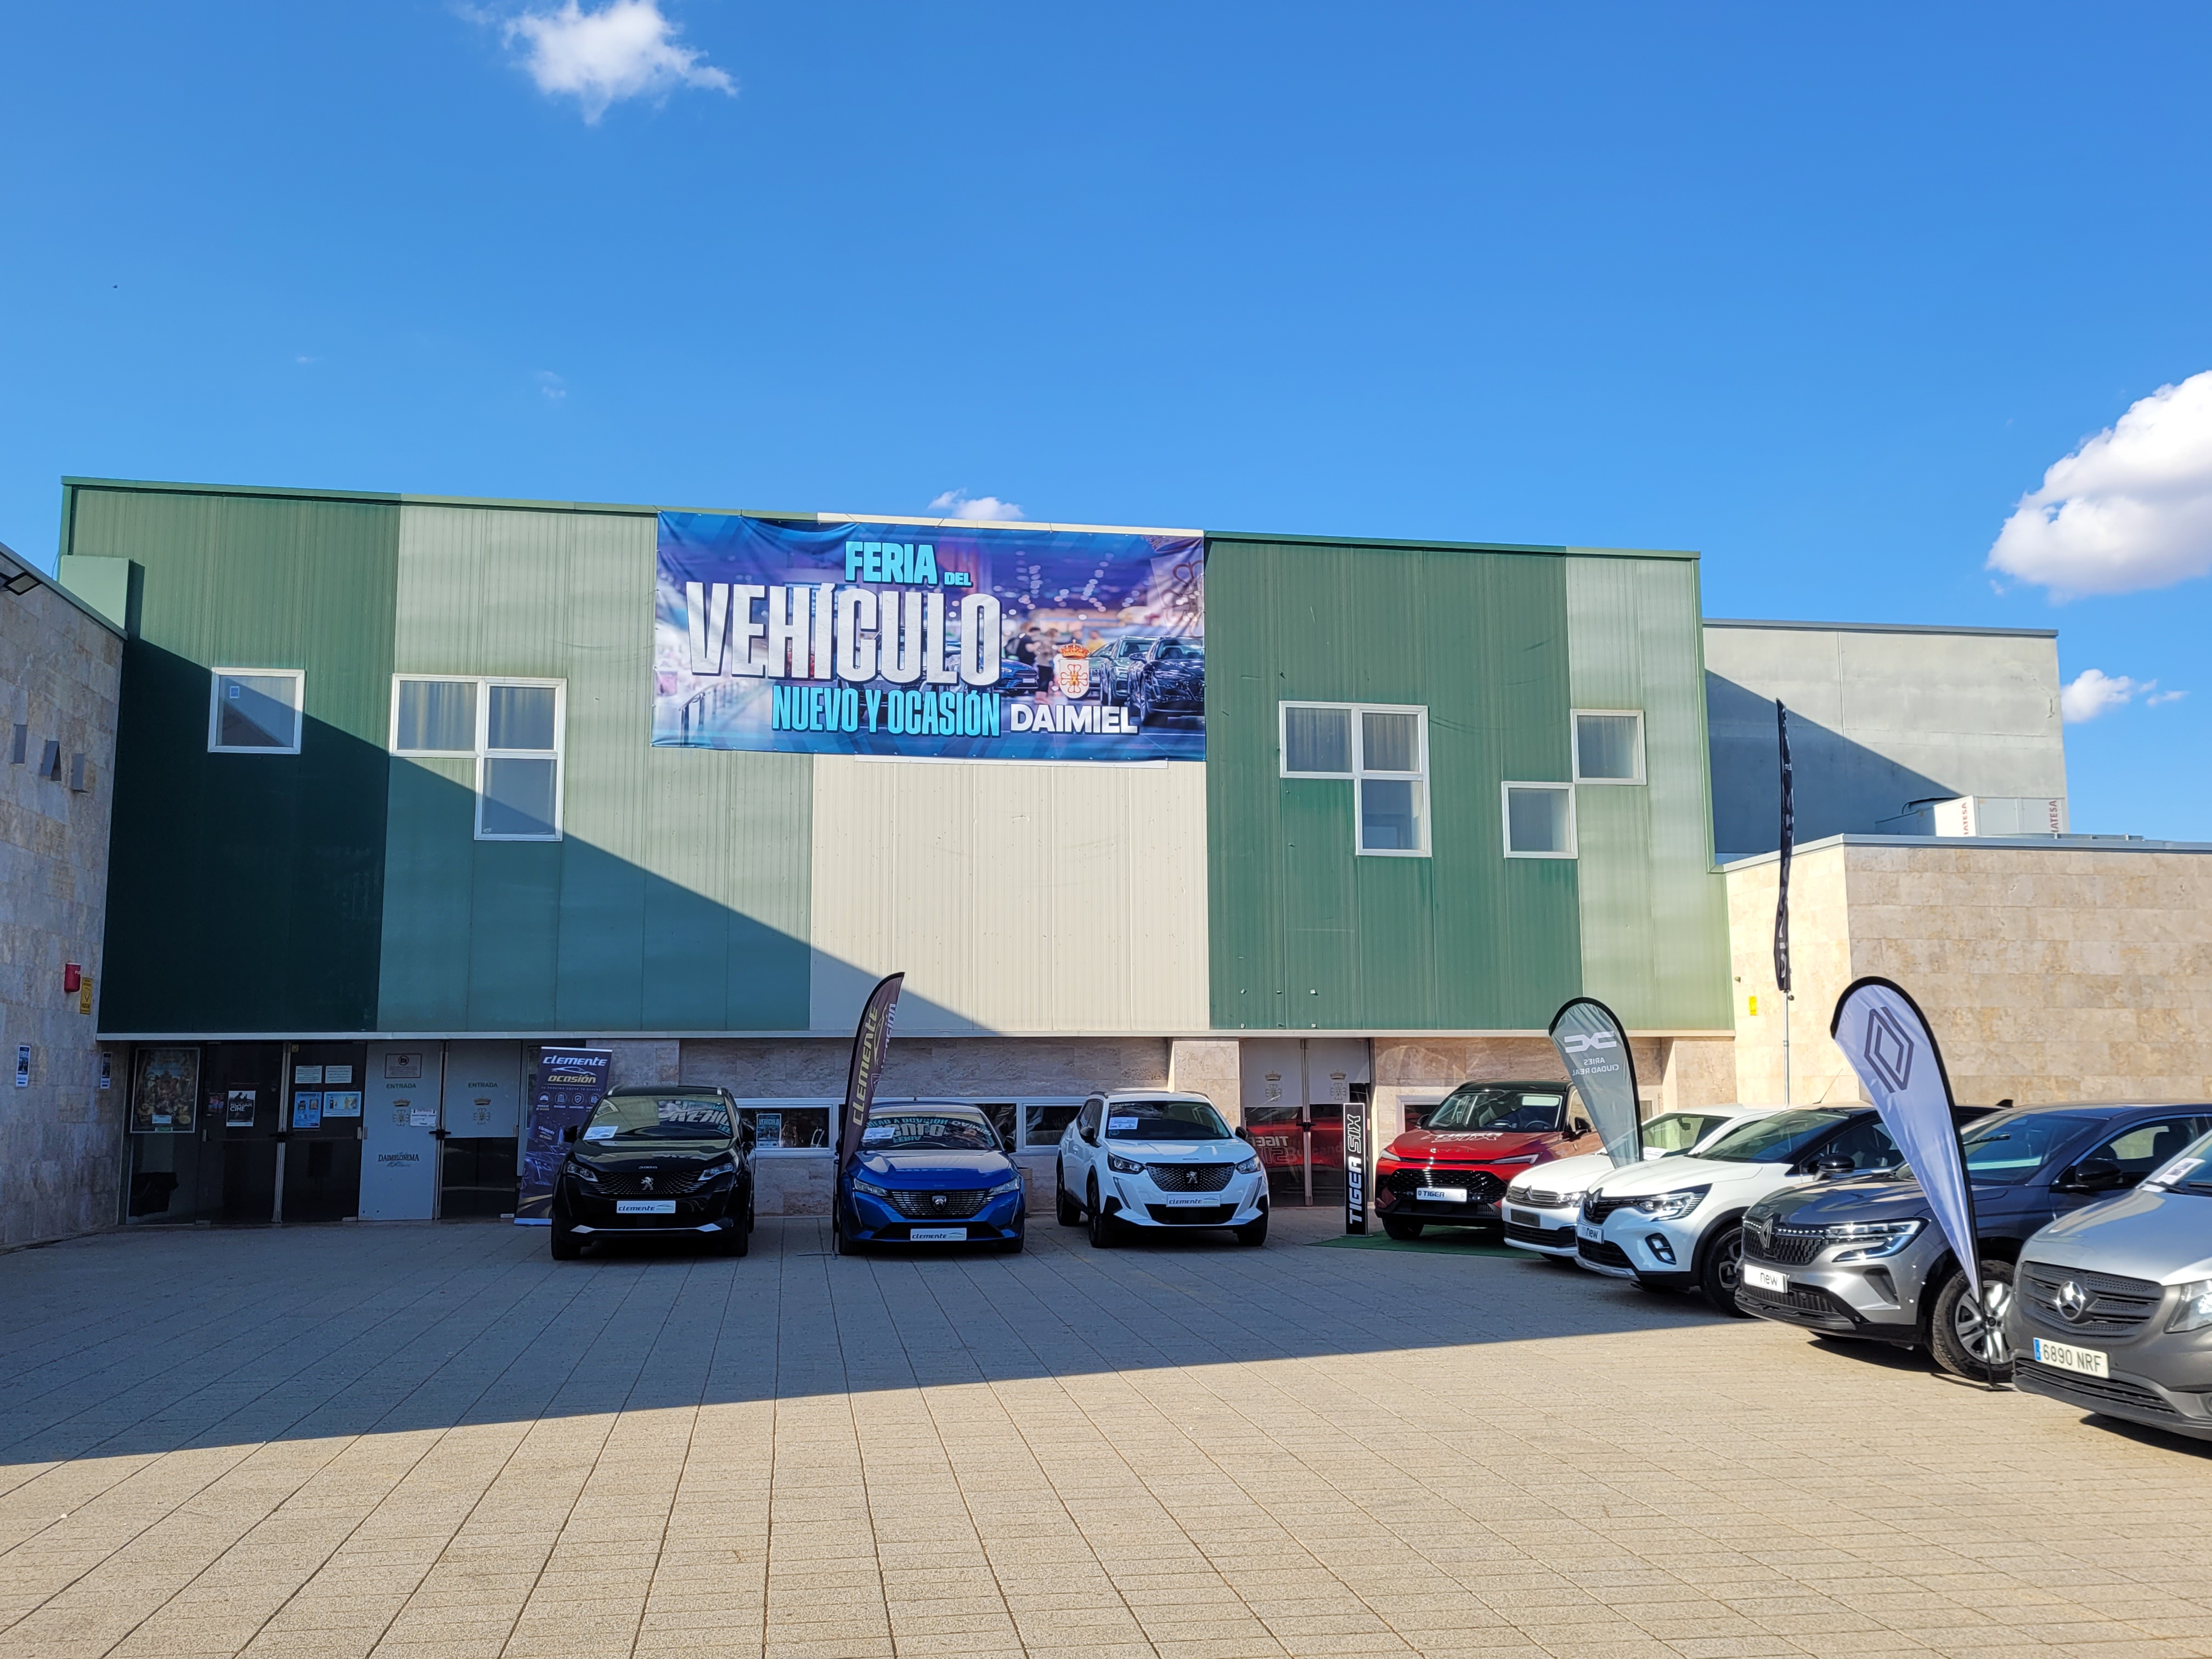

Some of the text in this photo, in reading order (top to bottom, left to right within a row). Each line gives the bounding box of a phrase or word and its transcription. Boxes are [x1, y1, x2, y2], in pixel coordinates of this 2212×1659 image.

[845, 541, 972, 586] FERIA DEL
[686, 581, 1002, 686] VEHÍCULO
[771, 685, 1001, 737] NUEVO Y OCASIÓN
[1010, 703, 1139, 734] DAIMIEL
[1961, 802, 1970, 835] IATESA
[2048, 799, 2059, 833] IATESA
[1347, 1114, 1363, 1225] SIX TIGER
[1760, 1272, 1778, 1286] new
[2042, 1344, 2073, 1366] 6890
[2076, 1351, 2102, 1373] NRF
